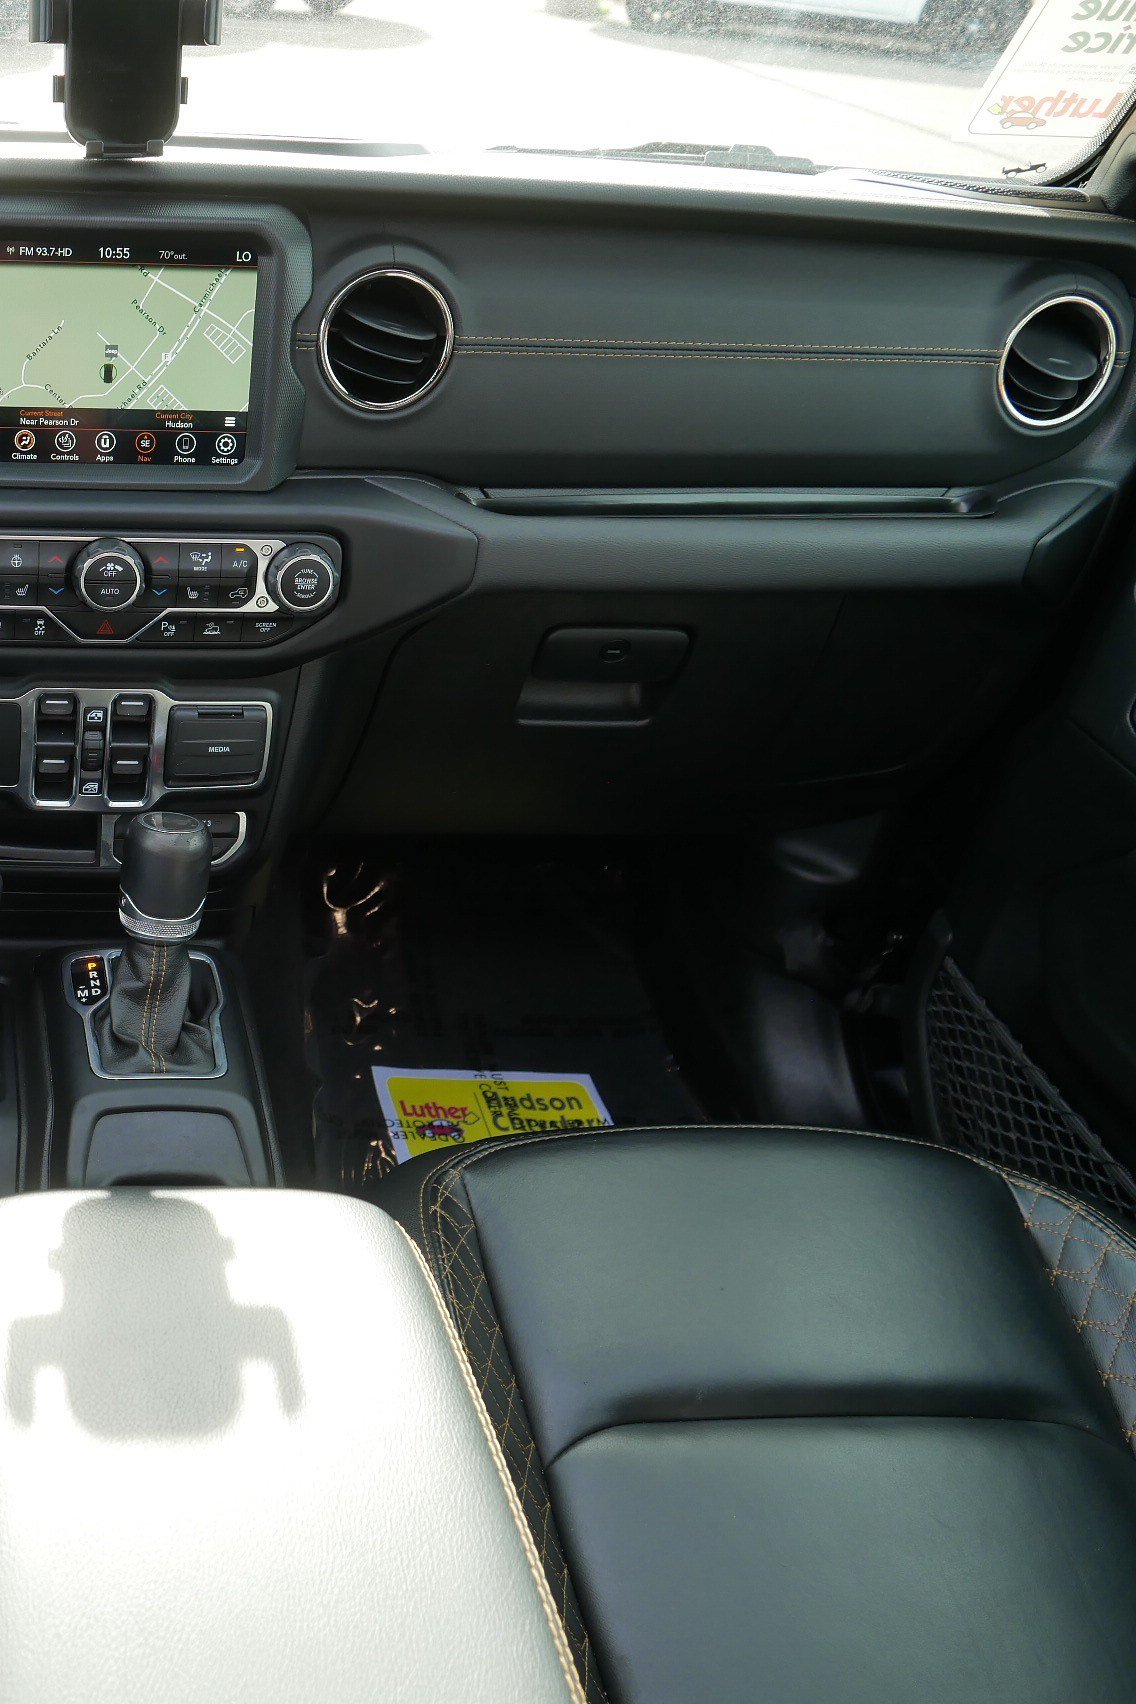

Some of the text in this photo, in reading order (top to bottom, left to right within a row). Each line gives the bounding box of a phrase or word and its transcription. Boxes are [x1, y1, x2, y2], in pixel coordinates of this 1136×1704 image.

[19, 246, 73, 257] FM 93.7-HD
[98, 247, 130, 259] 10:55
[236, 251, 252, 262] LO
[138, 265, 150, 278] Rd
[193, 269, 225, 313] Carmichael
[130, 299, 167, 336] Pearson Dr
[26, 325, 63, 361] Bantara Ln
[136, 380, 148, 391] Rd
[44, 383, 67, 406] Center
[155, 412, 195, 421] Current City
[39, 418, 69, 426] Pearson
[165, 420, 194, 429] Hudson
[95, 455, 114, 463] Apps
[173, 455, 196, 463] Phone
[211, 456, 239, 465] Settings
[232, 560, 248, 568] A/C
[89, 971, 98, 979] R
[77, 989, 89, 998] M
[91, 988, 101, 996] D
[400, 1100, 469, 1119] Luther
